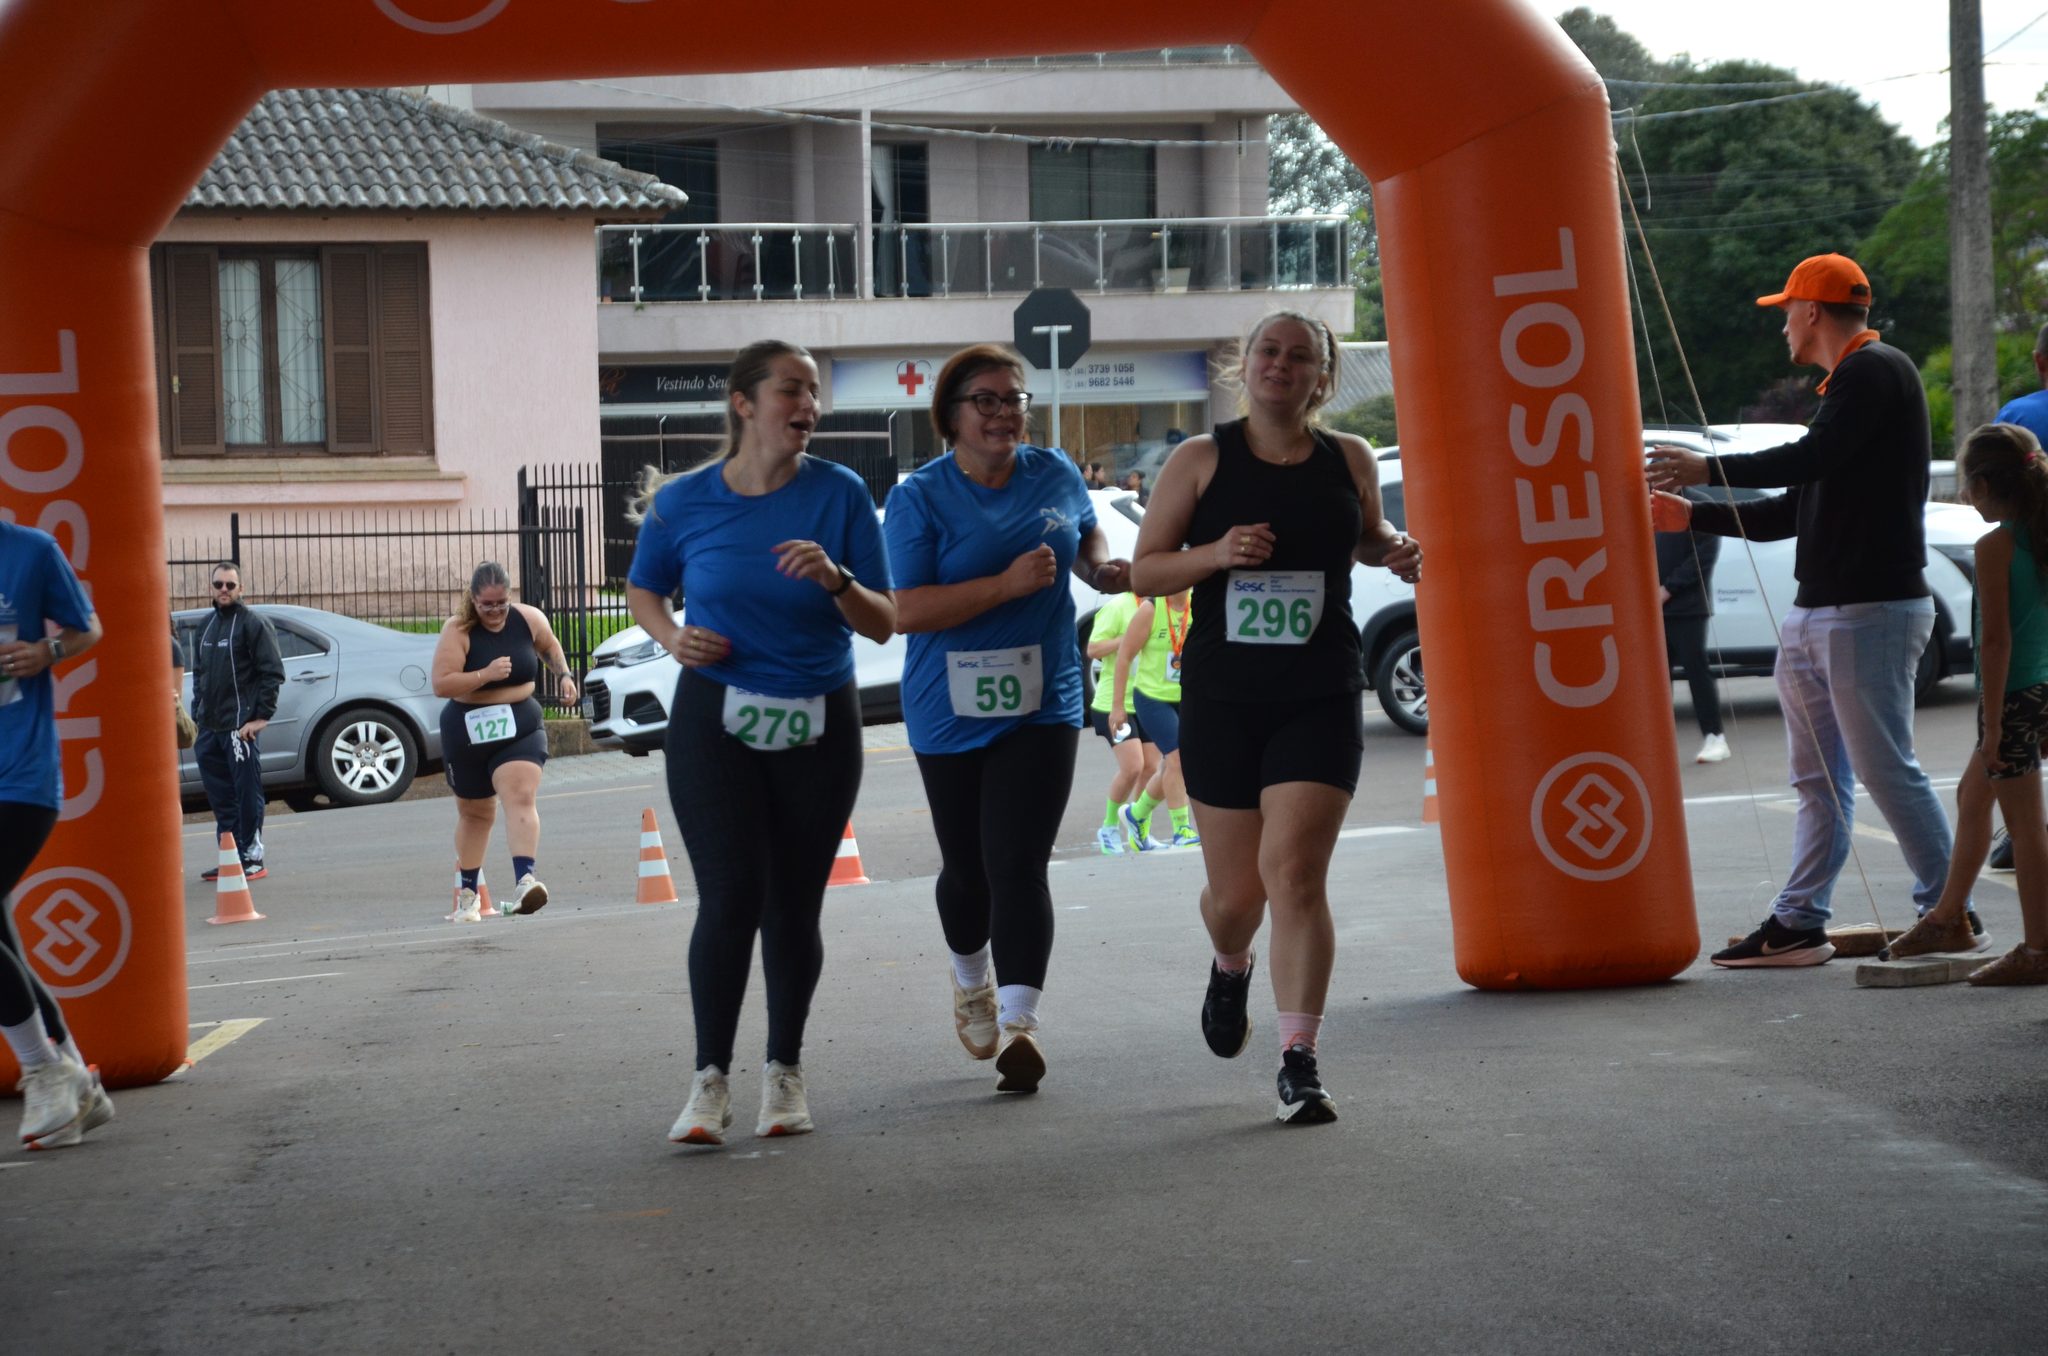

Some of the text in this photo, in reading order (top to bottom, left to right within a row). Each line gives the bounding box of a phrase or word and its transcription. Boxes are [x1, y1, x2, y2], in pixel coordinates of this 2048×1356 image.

[1088, 364, 1110, 374] 3739
[1113, 363, 1135, 373] 1058
[656, 375, 705, 392] Vestindo
[1088, 378, 1110, 387] 9682
[1113, 376, 1135, 386] 5446
[1492, 226, 1620, 708] CRESOL
[1234, 580, 1266, 592] Sesc
[1237, 597, 1312, 638] 296
[976, 674, 1022, 712] 59
[474, 717, 509, 741] 127
[735, 704, 811, 747] 279
